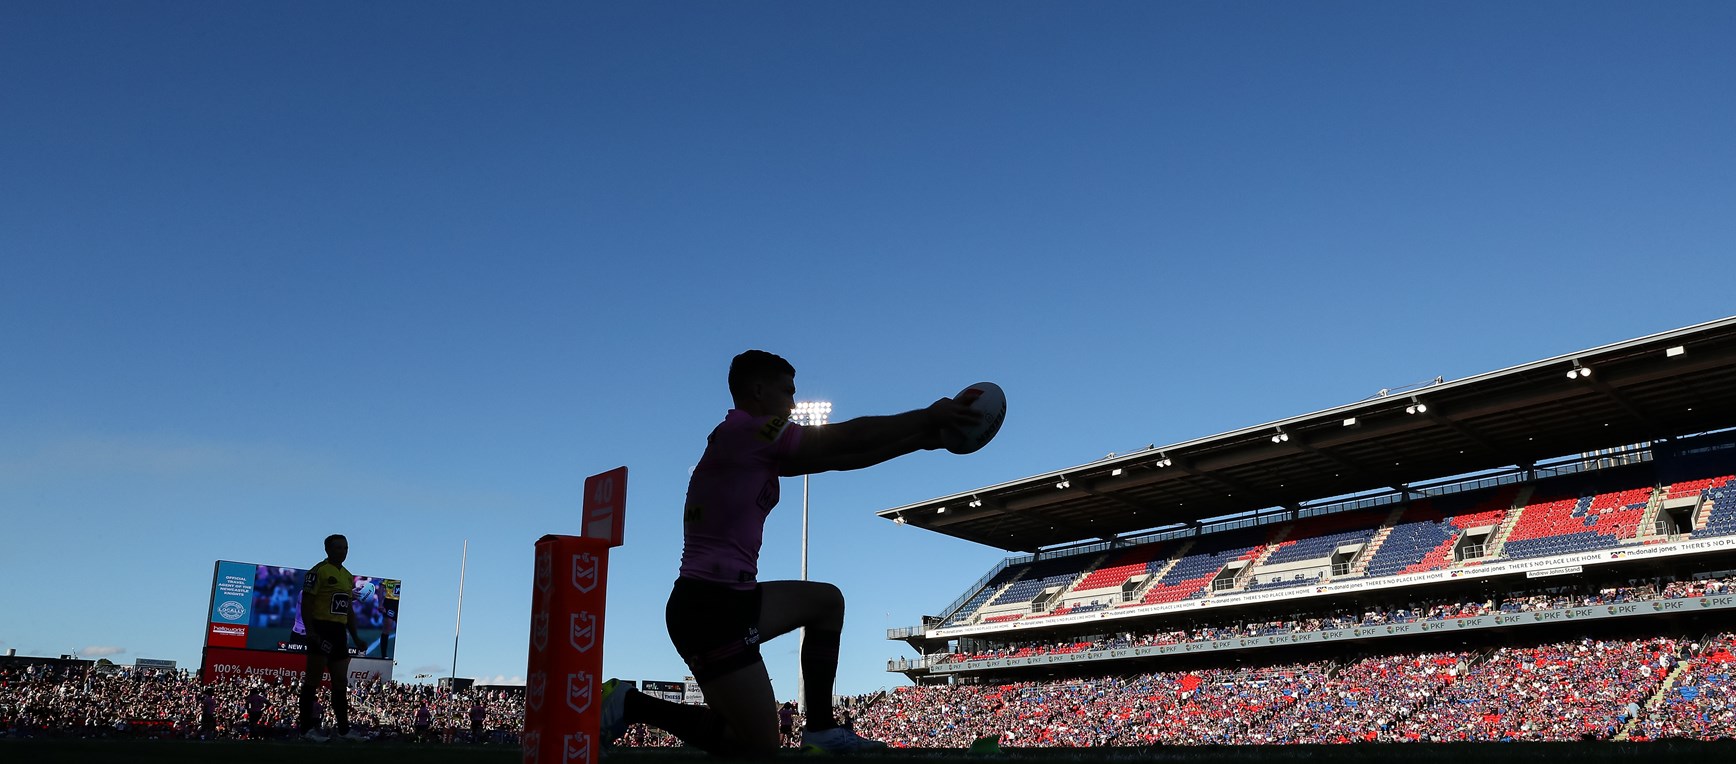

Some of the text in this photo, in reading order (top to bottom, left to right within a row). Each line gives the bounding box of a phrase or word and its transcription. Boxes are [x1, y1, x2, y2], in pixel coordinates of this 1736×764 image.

[760, 418, 786, 440] He
[594, 476, 613, 504] 40
[1681, 541, 1711, 549] THERE'S
[213, 664, 241, 674] 100%
[244, 666, 297, 677] Australian
[350, 671, 369, 679] red
